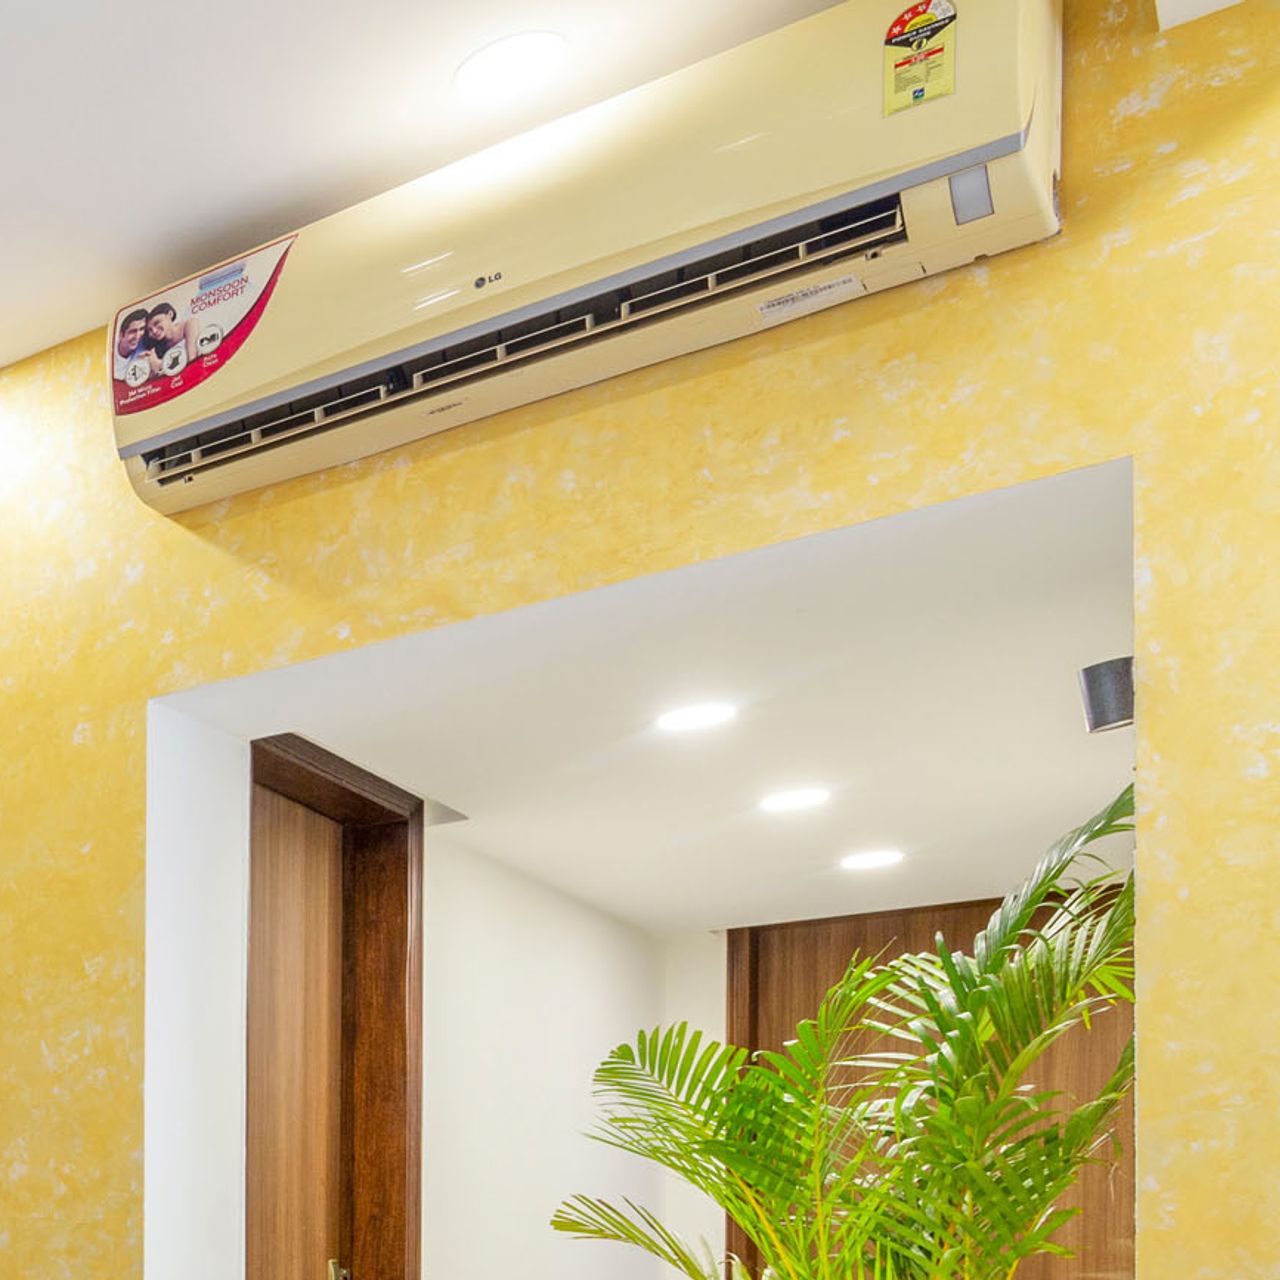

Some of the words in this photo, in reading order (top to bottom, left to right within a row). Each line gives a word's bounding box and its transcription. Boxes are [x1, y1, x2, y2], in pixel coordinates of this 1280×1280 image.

[190, 275, 248, 306] MONSOON
[488, 271, 502, 283] LG
[191, 284, 245, 314] COMFORT
